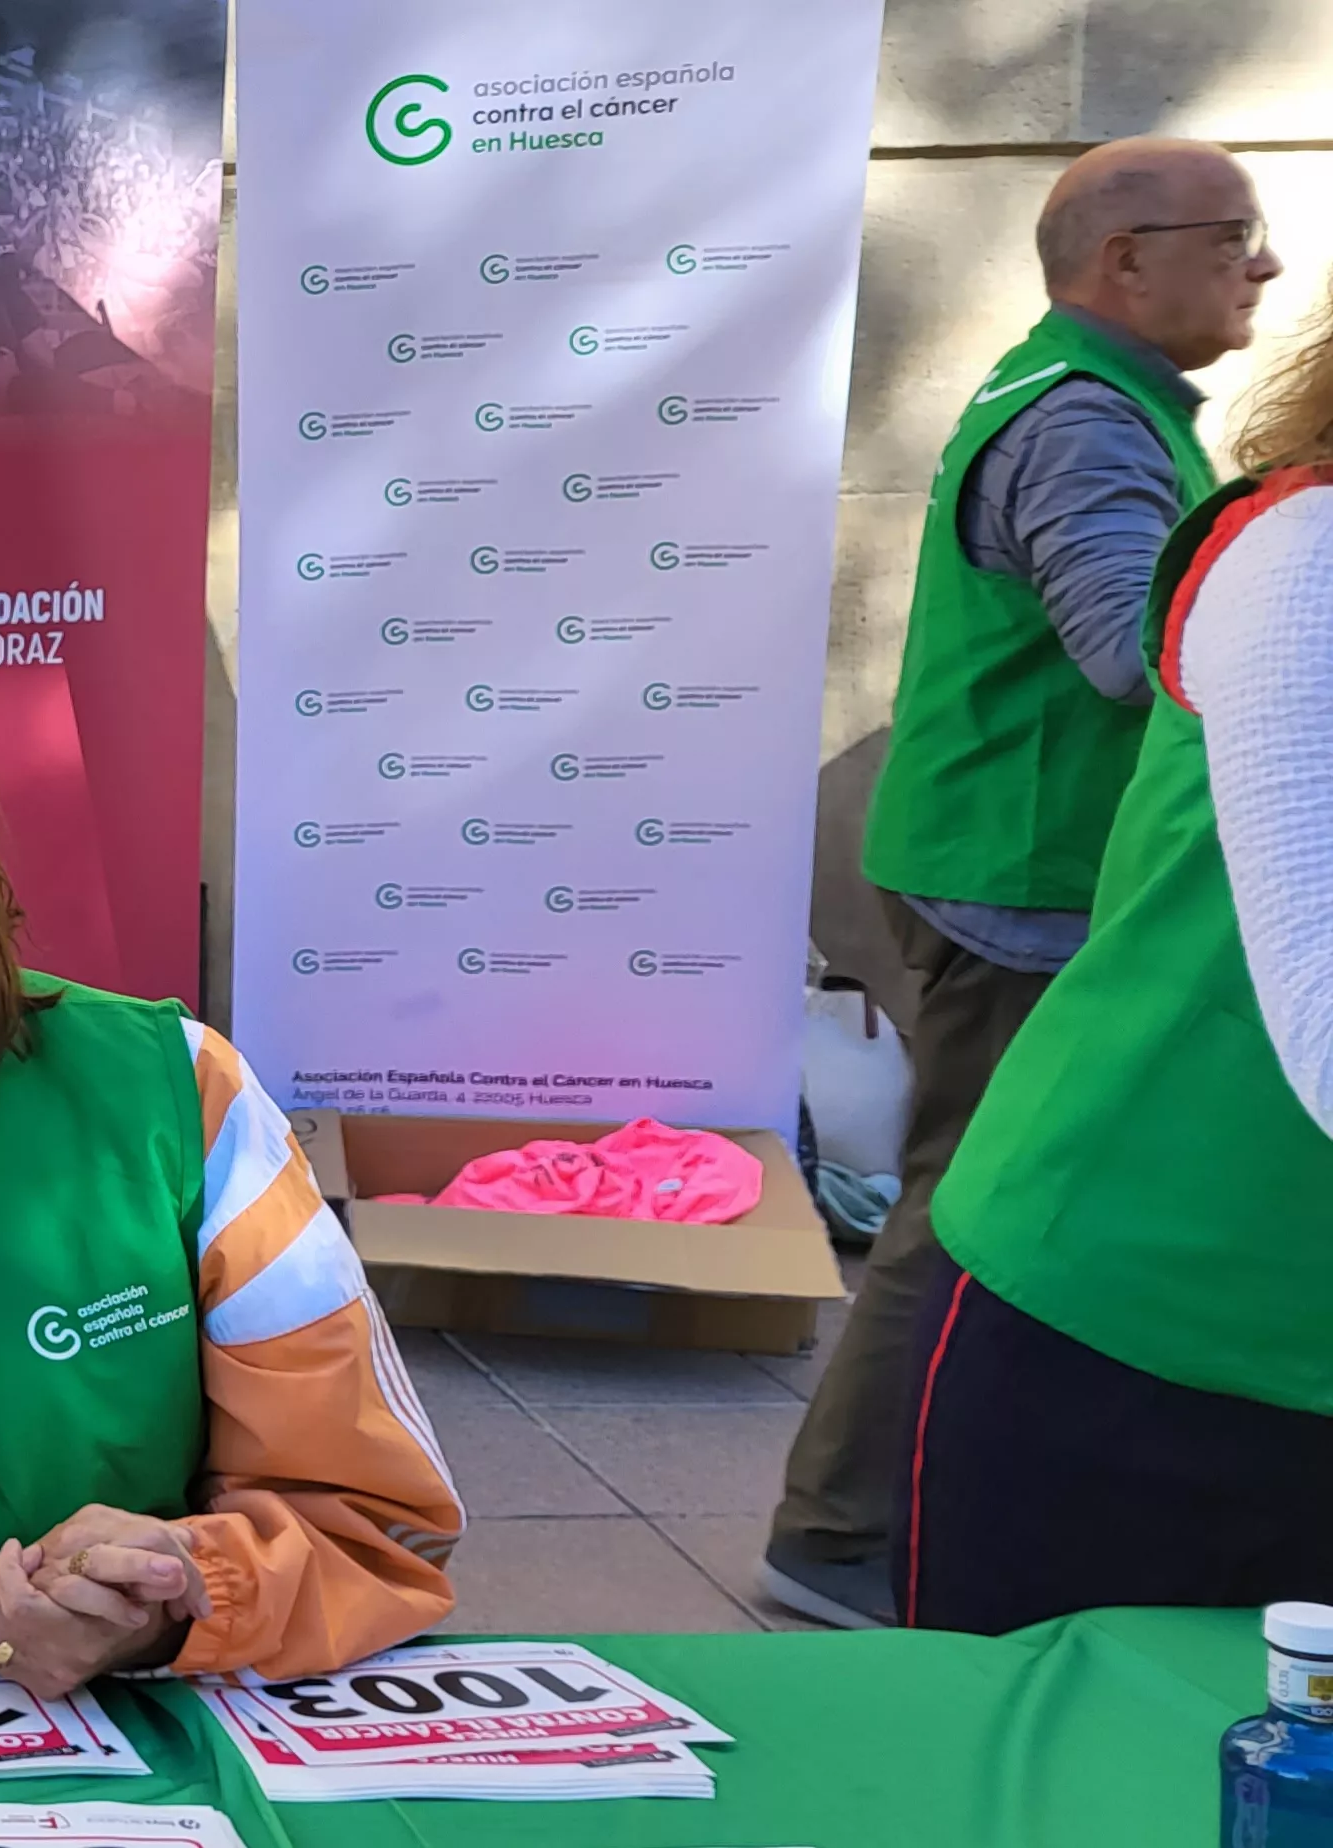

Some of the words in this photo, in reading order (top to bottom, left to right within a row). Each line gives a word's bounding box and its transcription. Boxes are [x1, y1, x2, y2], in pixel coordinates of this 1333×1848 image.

[473, 71, 608, 97] asociación
[615, 61, 735, 91] española
[472, 103, 554, 125] contra
[561, 99, 582, 119] el
[589, 96, 679, 117] cáncer
[472, 137, 502, 153] en
[509, 130, 604, 151] Huesca
[470, 1072, 528, 1087] Contra
[532, 1074, 548, 1087] el
[646, 1076, 713, 1090] Huesca
[77, 1284, 149, 1318] asociación
[83, 1303, 144, 1333] española
[89, 1325, 134, 1348] contra
[134, 1317, 148, 1332] el
[148, 1304, 190, 1328] cáncer
[261, 1667, 612, 1718] 1003
[312, 1720, 455, 1740] CÁNCER
[463, 1717, 502, 1731] EL
[502, 1708, 650, 1728] CONTRA
[442, 1727, 549, 1741] HUESCA
